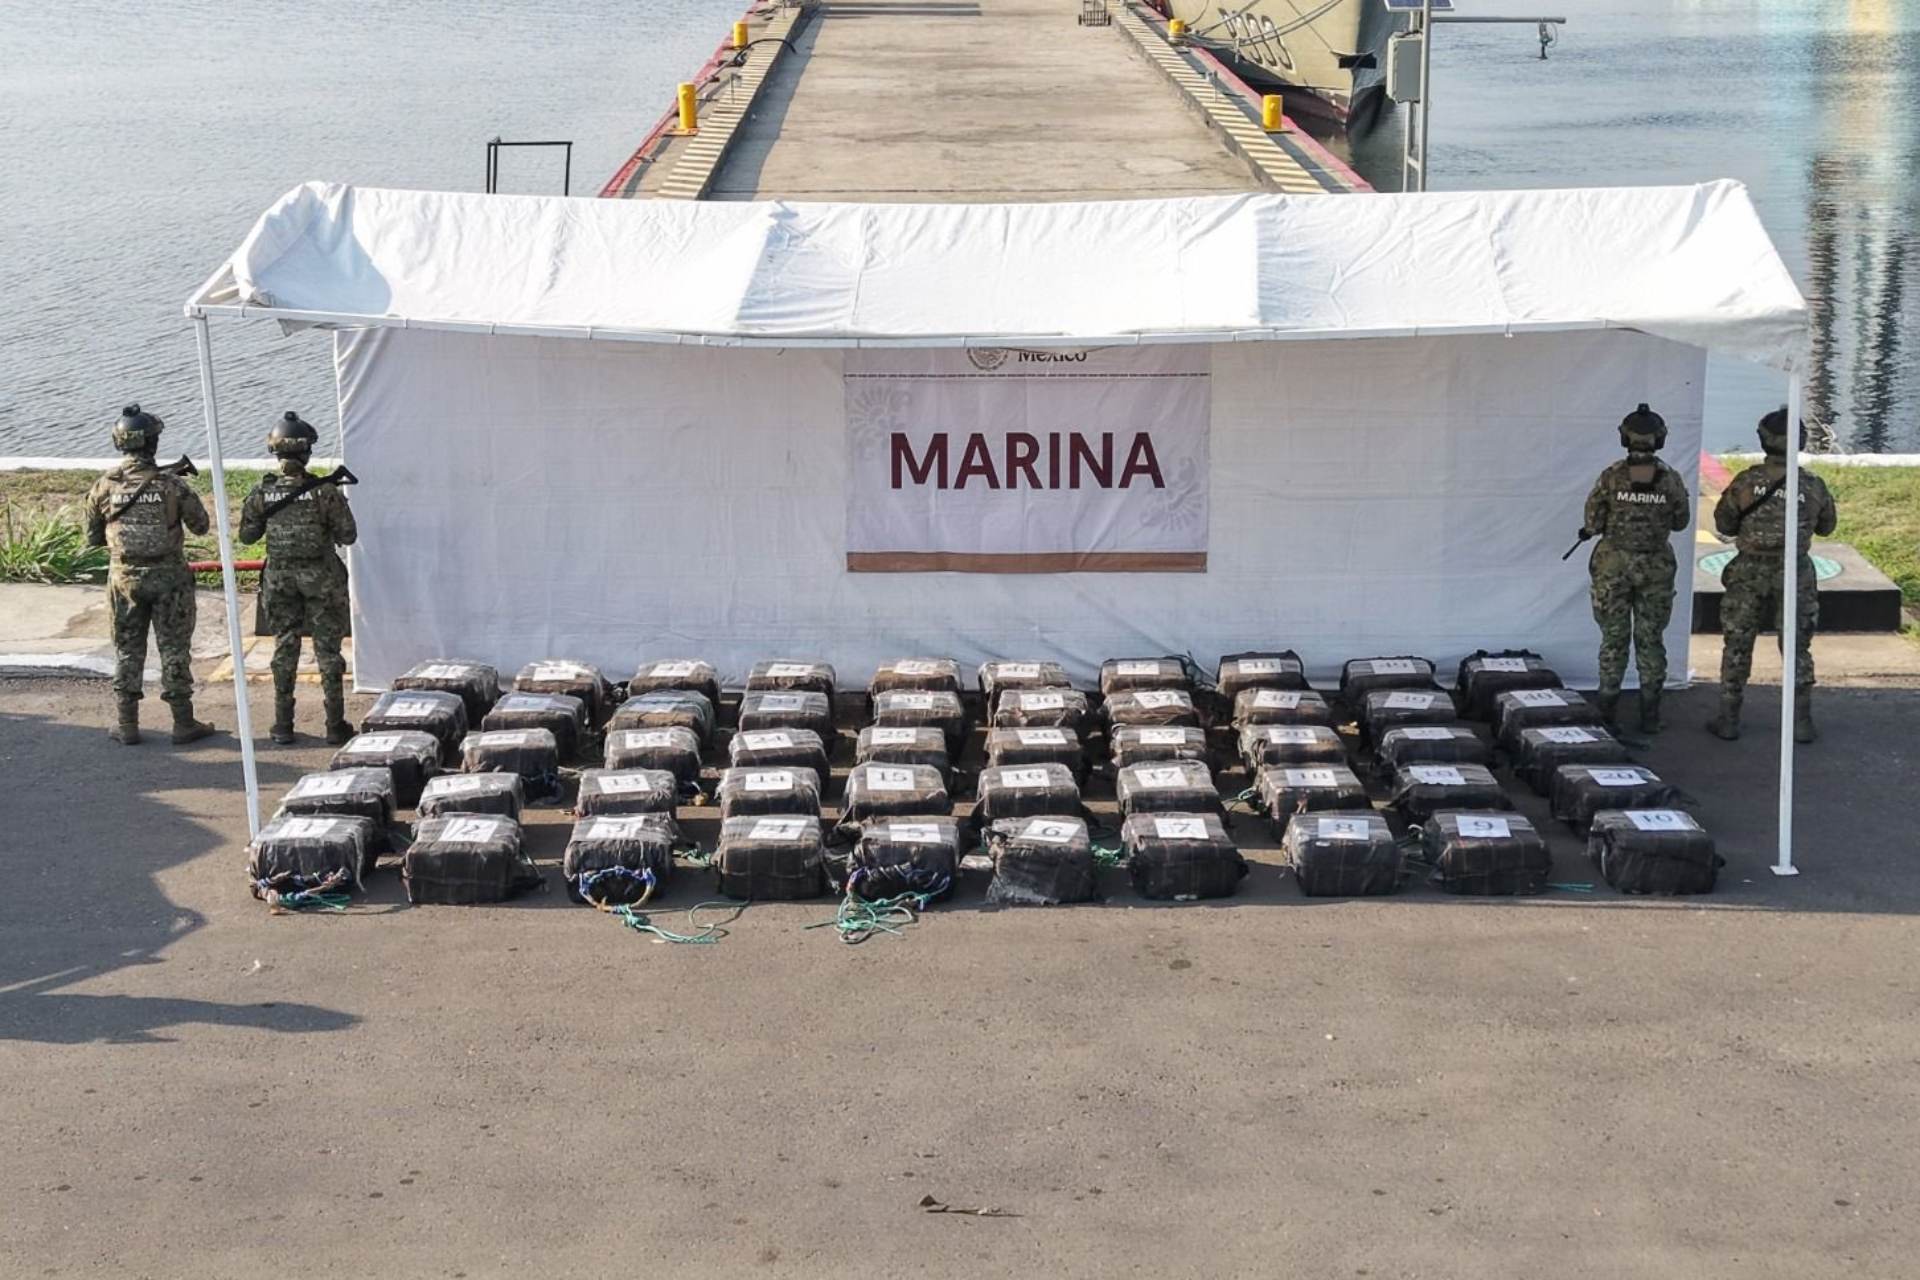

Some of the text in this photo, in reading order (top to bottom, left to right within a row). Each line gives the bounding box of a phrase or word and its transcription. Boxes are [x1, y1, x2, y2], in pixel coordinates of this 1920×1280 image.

[890, 432, 1166, 490] MARINA
[111, 492, 162, 504] MAINA
[1617, 491, 1667, 505] MARINA
[880, 771, 908, 782] 15
[1424, 770, 1455, 778] 19
[1599, 771, 1634, 780] 20
[1641, 814, 1674, 824] 10
[1041, 826, 1063, 838] 6
[1171, 823, 1192, 833] 7
[1335, 823, 1355, 834] 8
[1473, 821, 1494, 832] 9
[906, 827, 926, 838] 5
